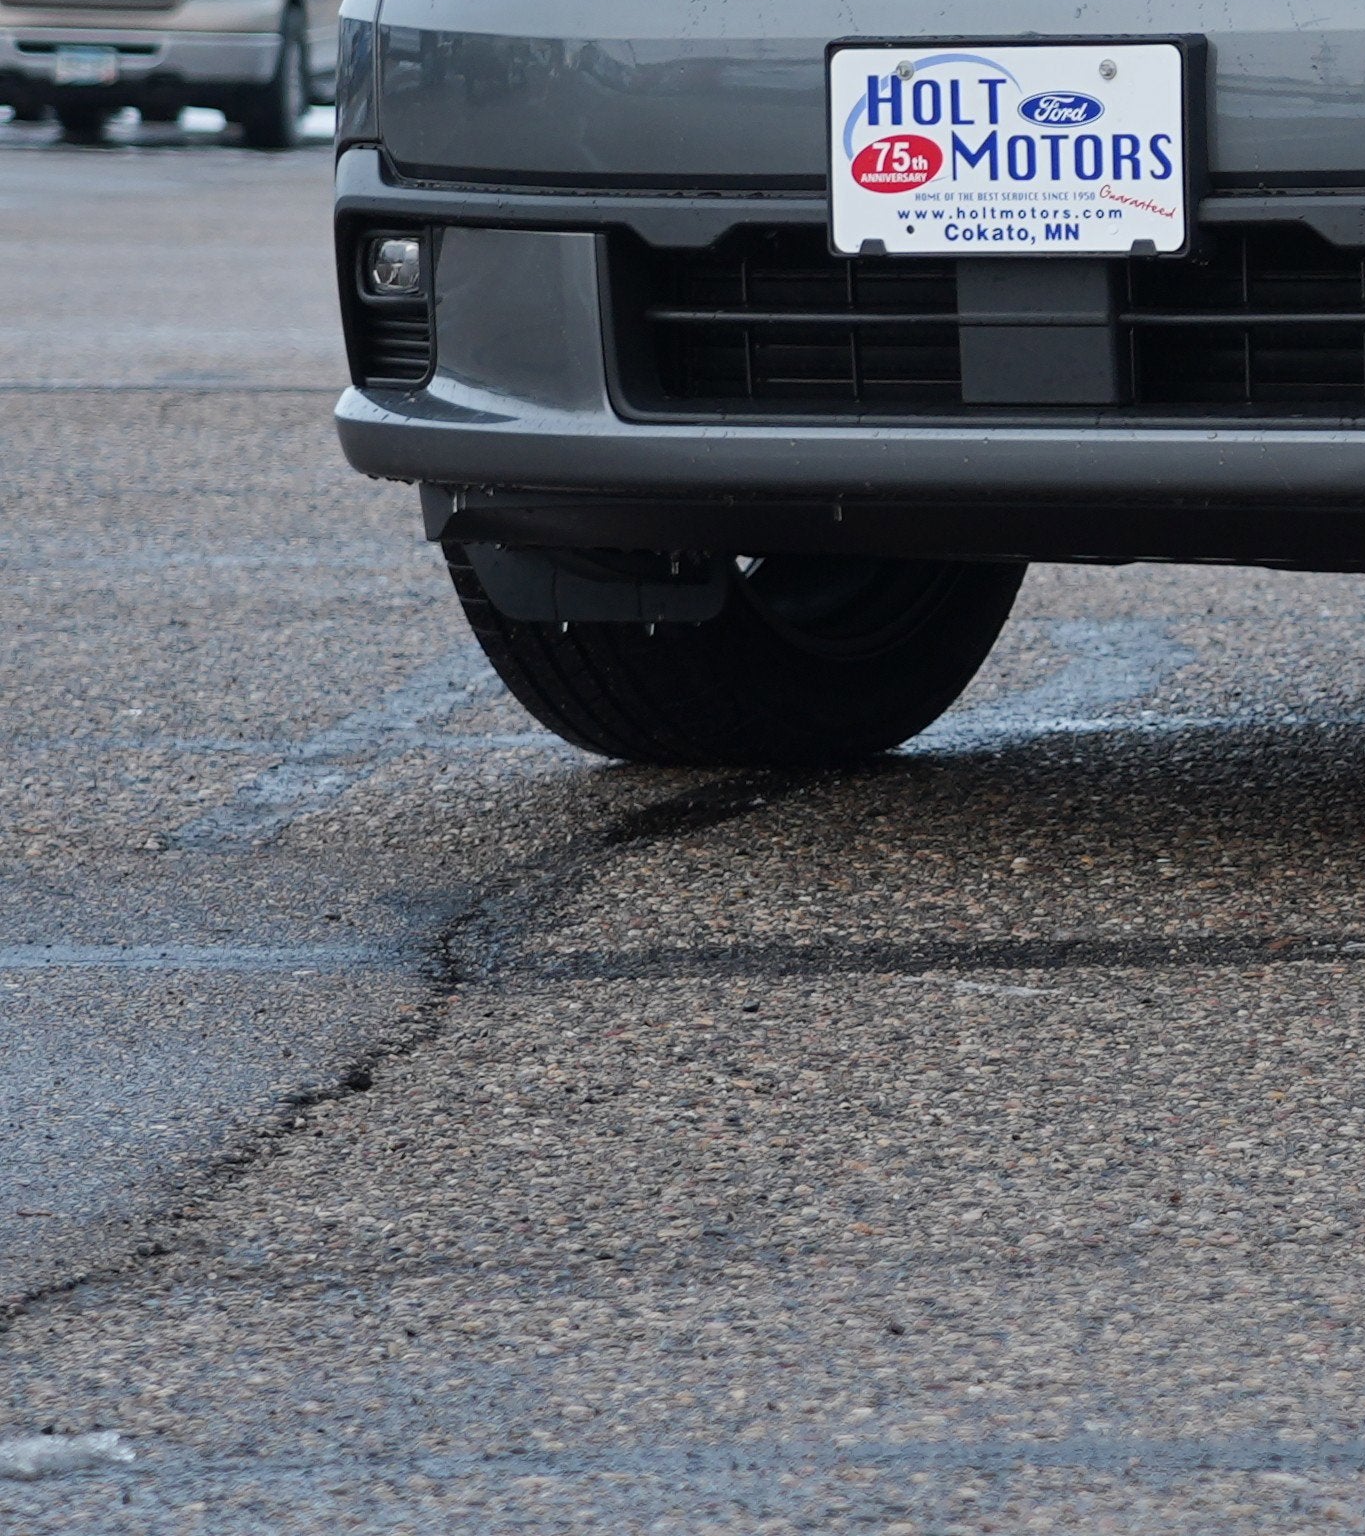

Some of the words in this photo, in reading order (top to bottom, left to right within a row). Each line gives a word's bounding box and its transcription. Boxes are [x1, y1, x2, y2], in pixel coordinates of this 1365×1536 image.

[867, 75, 1006, 126] HOLT
[1034, 96, 1087, 123] Ford
[872, 142, 929, 173] 75th
[952, 130, 1172, 181] MOTORS
[860, 172, 928, 183] ANNIVERSARY
[915, 193, 940, 202] HOME
[944, 193, 955, 202] OF
[958, 193, 975, 202] THE
[977, 192, 1000, 201] BEST
[1042, 192, 1070, 201] SINCE
[1073, 192, 1096, 201] 1950
[1100, 185, 1176, 218] Guaranteed
[898, 207, 1123, 220] www.holtmotors.com
[944, 223, 1036, 245] Cokato,
[1044, 223, 1080, 241] MN
